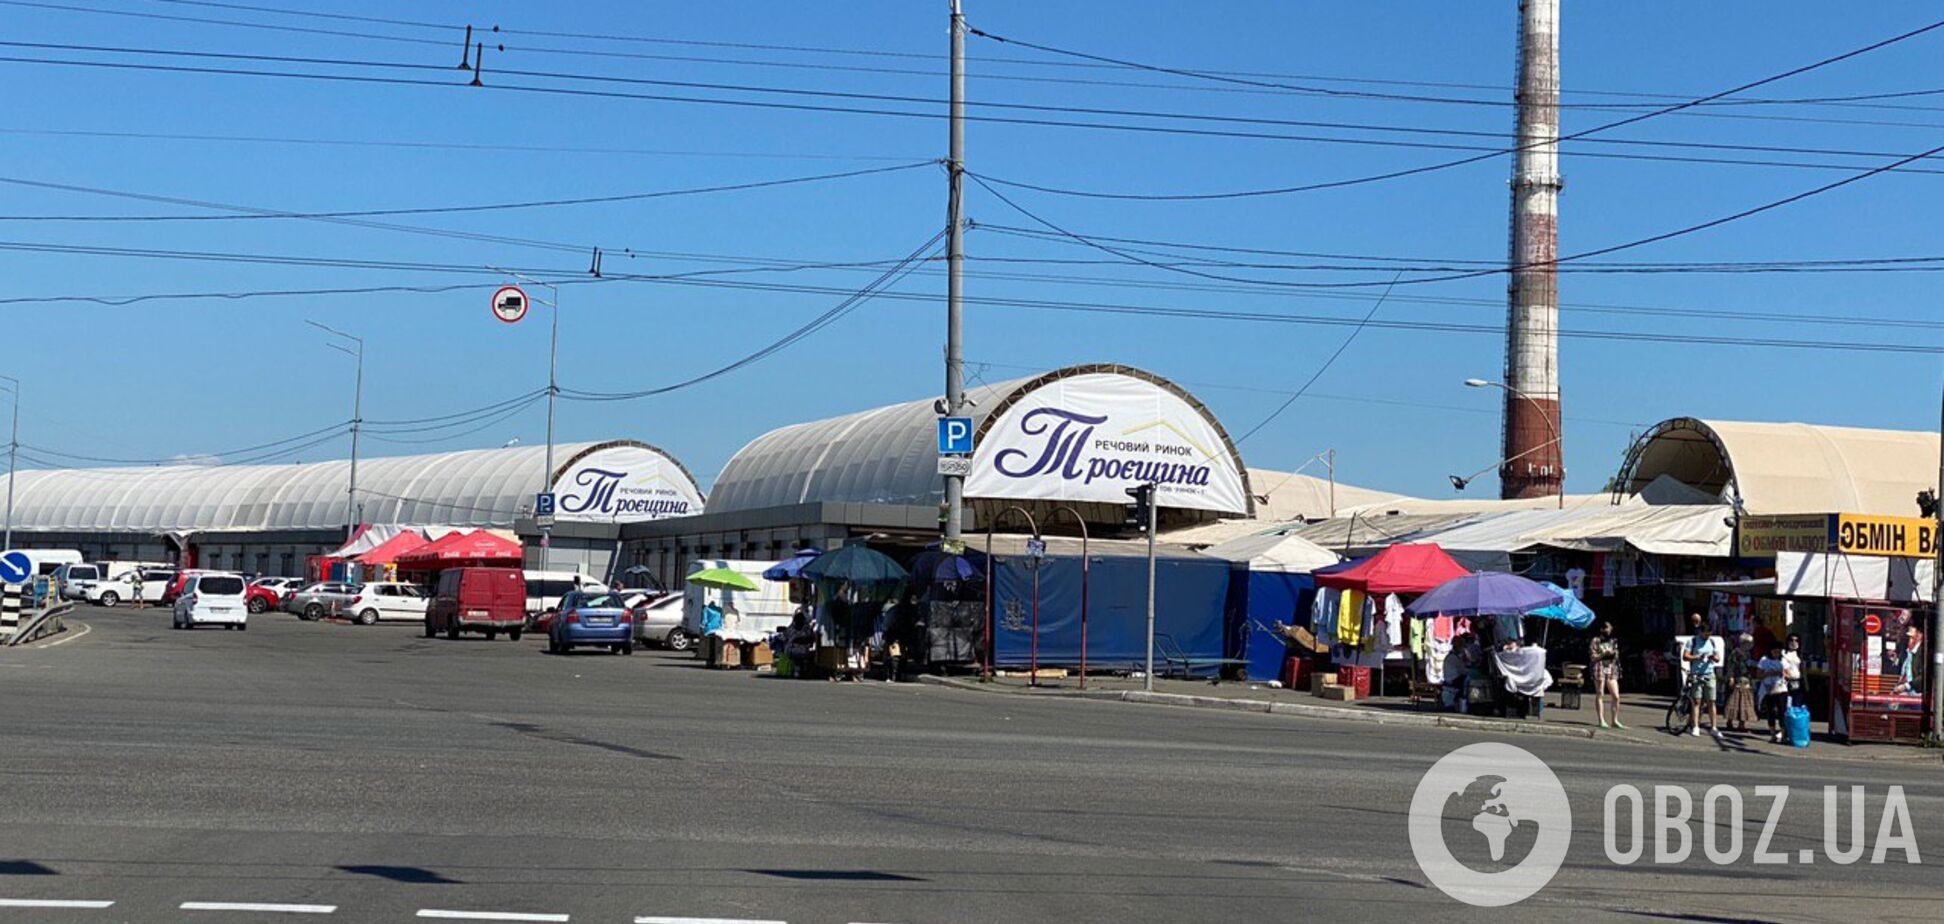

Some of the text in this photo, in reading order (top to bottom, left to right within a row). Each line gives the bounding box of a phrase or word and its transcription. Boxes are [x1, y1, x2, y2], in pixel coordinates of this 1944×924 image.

[948, 421, 966, 449] P
[994, 407, 1210, 485] Троєщина
[1095, 440, 1192, 456] РЕЧОВИЙ РИНОК
[559, 468, 688, 517] Троєщина
